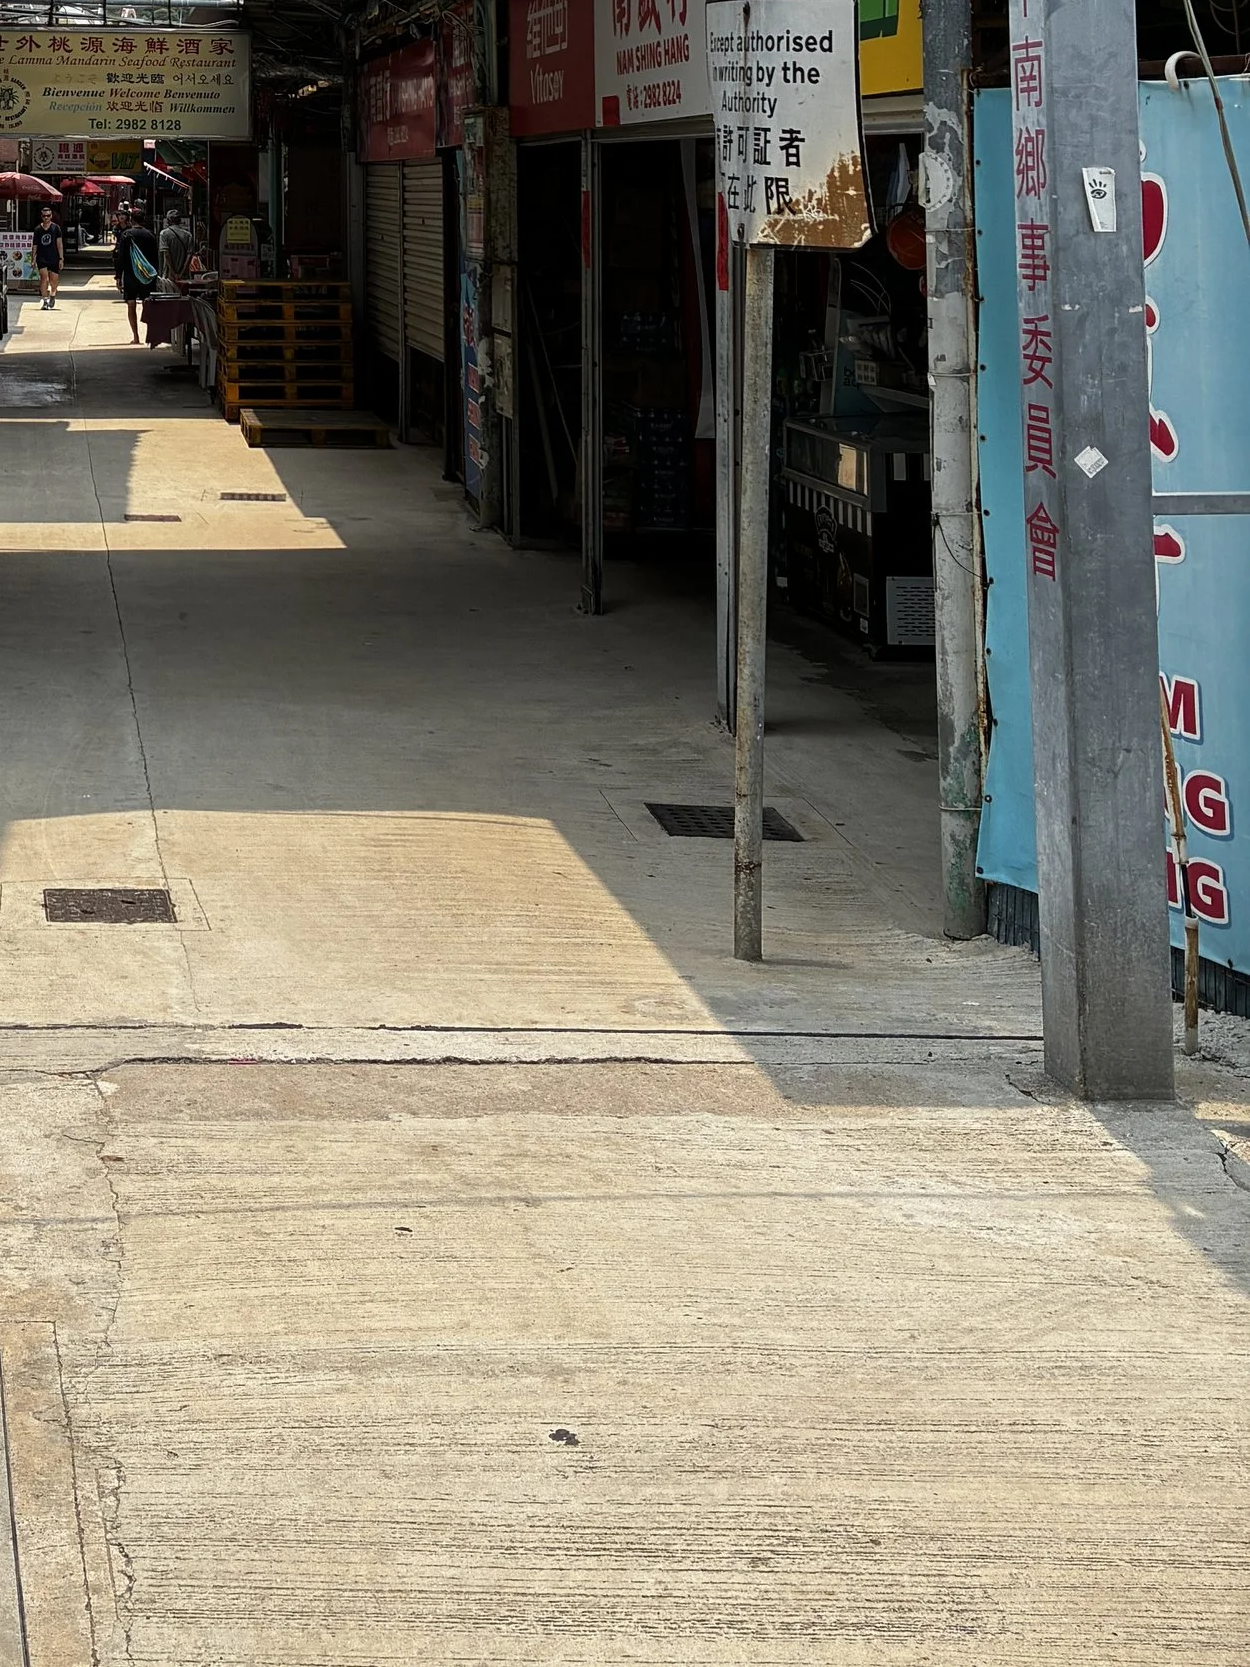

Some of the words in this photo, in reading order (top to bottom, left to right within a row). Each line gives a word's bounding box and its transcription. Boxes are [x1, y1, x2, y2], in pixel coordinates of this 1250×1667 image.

[710, 32, 734, 57] Except
[736, 29, 834, 54] authorised
[8, 54, 52, 65] Lamma
[56, 54, 116, 66] Mandarin
[118, 55, 170, 69] Seafood
[170, 56, 237, 69] Restaurant
[616, 46, 635, 76] NAM
[635, 41, 662, 73] SHING
[663, 33, 690, 66] HANG
[51, 73, 98, 85] ようこそ
[106, 72, 165, 85] 歡迎光臨
[172, 73, 235, 86] 어서오세요
[717, 62, 753, 86] writing
[756, 61, 776, 87] by
[782, 61, 821, 84] the
[530, 63, 564, 105] Vitasoy
[42, 87, 105, 98] Bienvenue
[109, 88, 161, 99] Welcome
[163, 89, 221, 99] Benvenuto
[643, 81, 662, 109] 2982
[662, 79, 682, 107] 8224
[106, 100, 164, 113] 欢迎光临
[169, 103, 235, 114] Willkommen
[721, 90, 778, 119] Authority
[88, 118, 111, 130] Tel:
[116, 119, 146, 130] 2982
[150, 119, 181, 131] 8128
